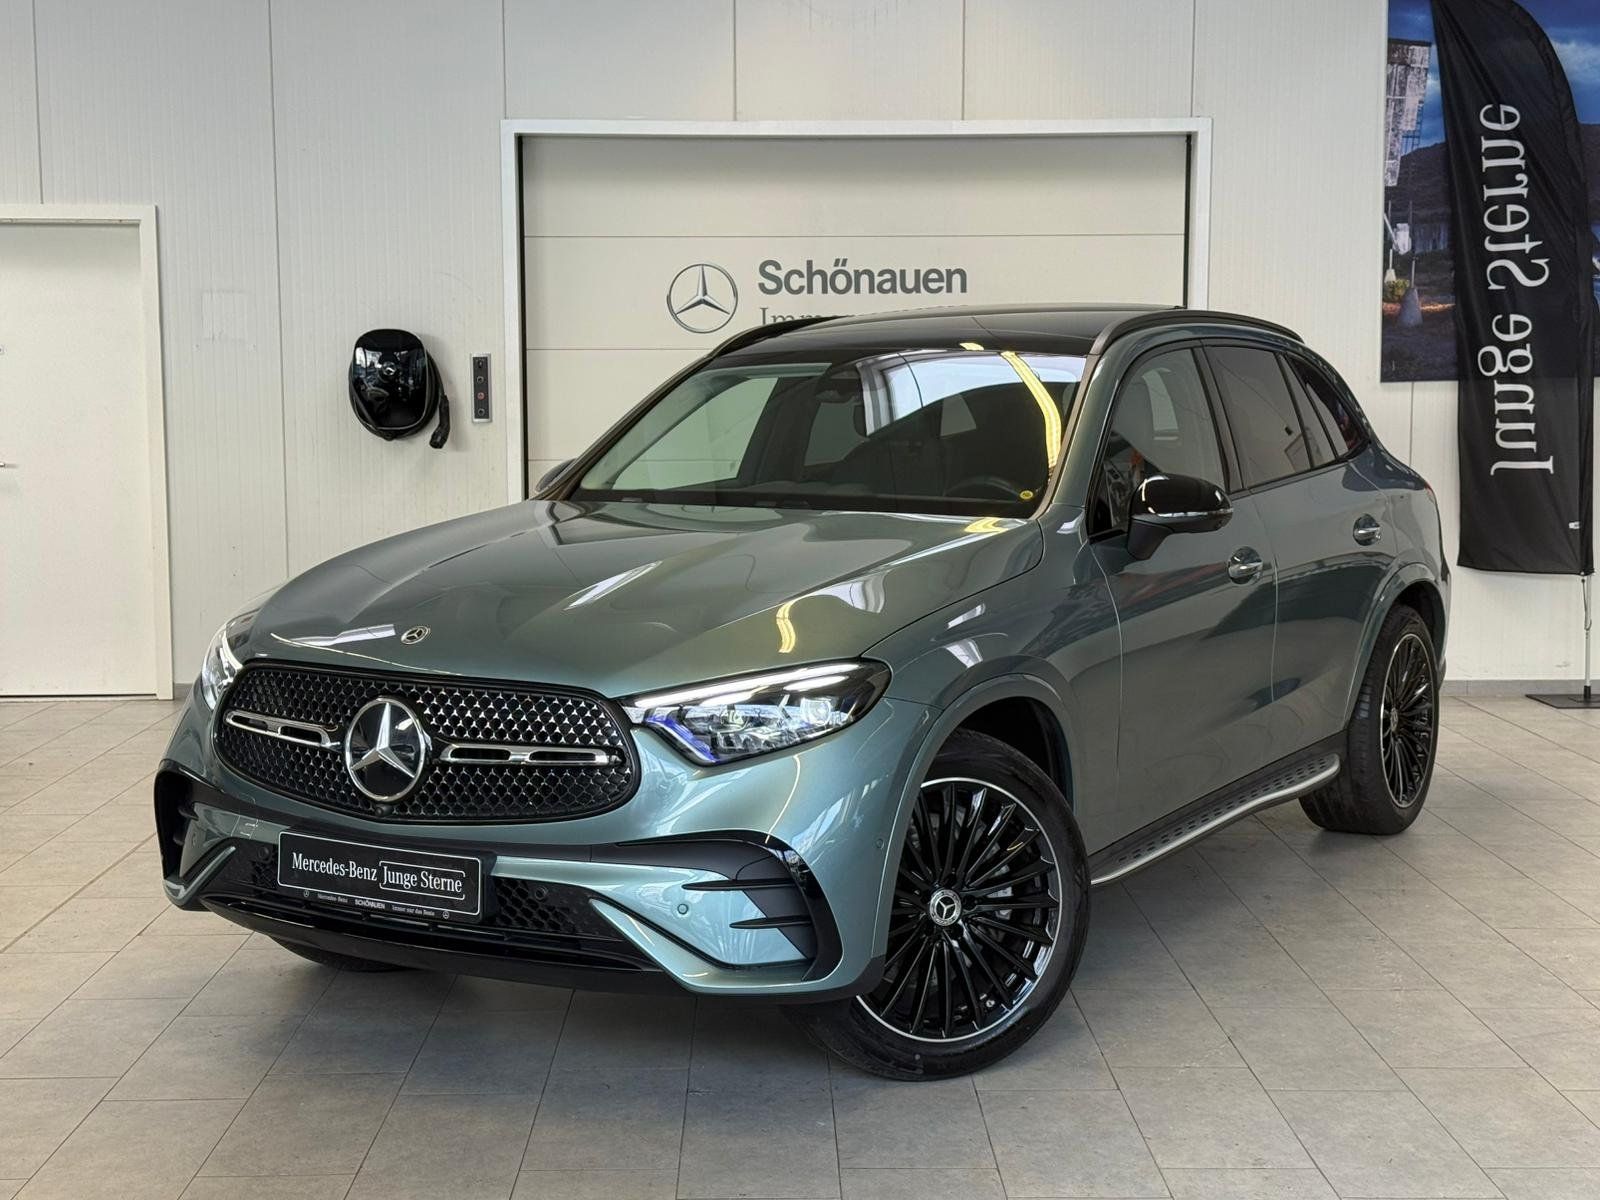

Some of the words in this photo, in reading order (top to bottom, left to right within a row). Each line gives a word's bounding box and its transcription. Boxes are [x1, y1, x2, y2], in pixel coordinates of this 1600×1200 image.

[757, 258, 967, 295] Schönauen
[292, 852, 378, 881] Mercedes-Benz
[382, 866, 418, 888] Junge
[420, 870, 463, 893] Sterne
